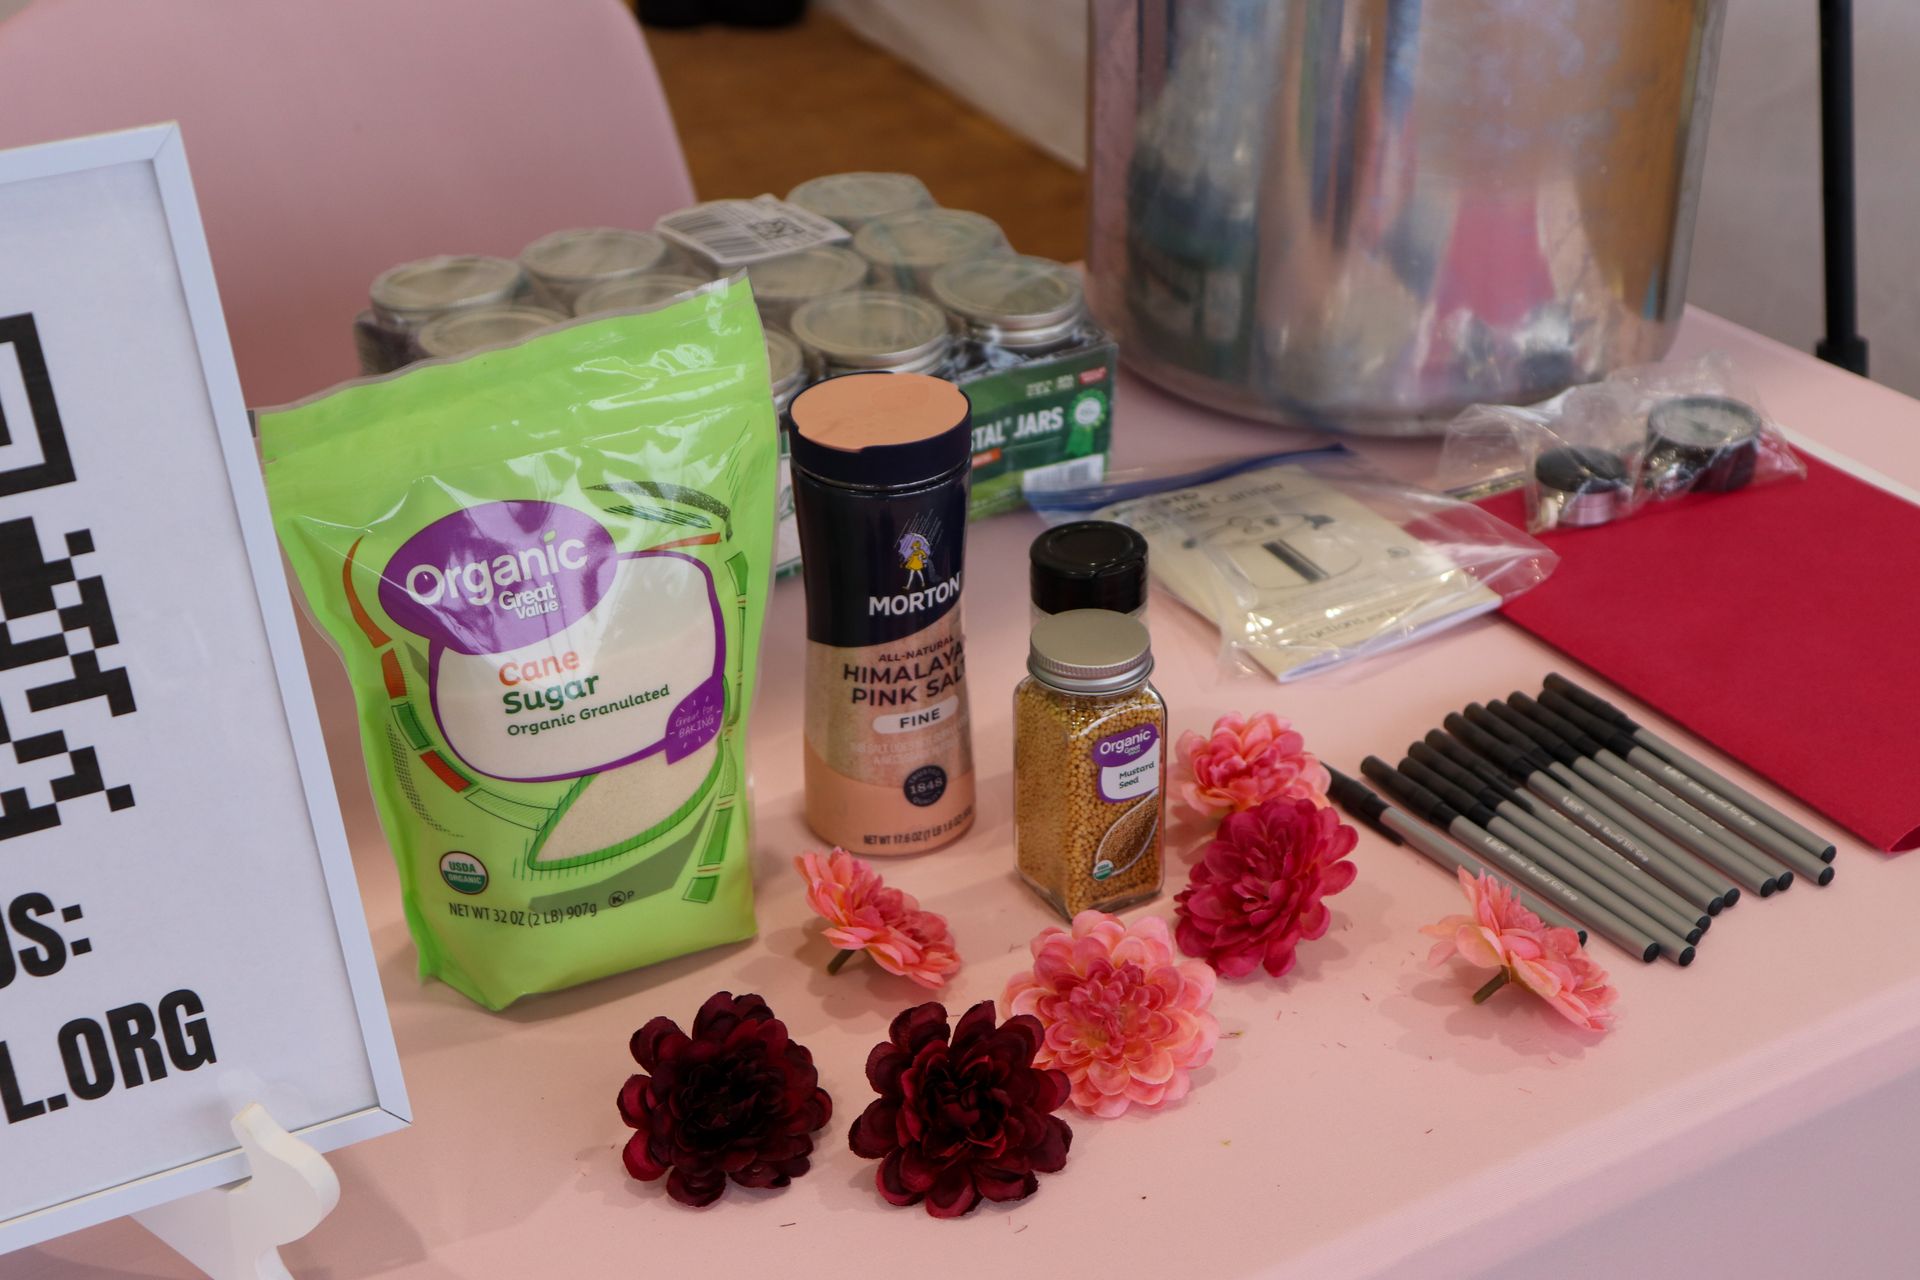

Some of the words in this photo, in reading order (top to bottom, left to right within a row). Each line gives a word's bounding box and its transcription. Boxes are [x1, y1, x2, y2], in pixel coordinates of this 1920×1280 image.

[1013, 406, 1064, 439] JARS
[406, 530, 588, 605] Organic
[499, 581, 556, 610] Great
[868, 571, 962, 616] MORTON
[515, 600, 559, 619] Value
[499, 651, 580, 686] Cane
[843, 641, 964, 685] HIMALAYA
[502, 674, 600, 714] Sugar
[851, 686, 918, 706] PINK
[507, 713, 576, 736] Organic
[579, 684, 671, 720] Granulated
[900, 707, 941, 729] FINE
[679, 714, 714, 738] BAKING
[1100, 729, 1151, 755] Organic
[1119, 761, 1155, 779] Mustard
[1119, 776, 1139, 789] Seed
[911, 778, 943, 794] 1848
[864, 834, 877, 845] NET
[448, 861, 477, 873] USDA
[449, 902, 469, 918] NET
[472, 905, 491, 920] WT
[494, 908, 507, 923] 32
[510, 911, 525, 926] OZ
[528, 912, 540, 928] (2
[544, 907, 564, 925] LB)
[567, 902, 597, 920] 907g
[0, 989, 217, 1124] L.ORG
